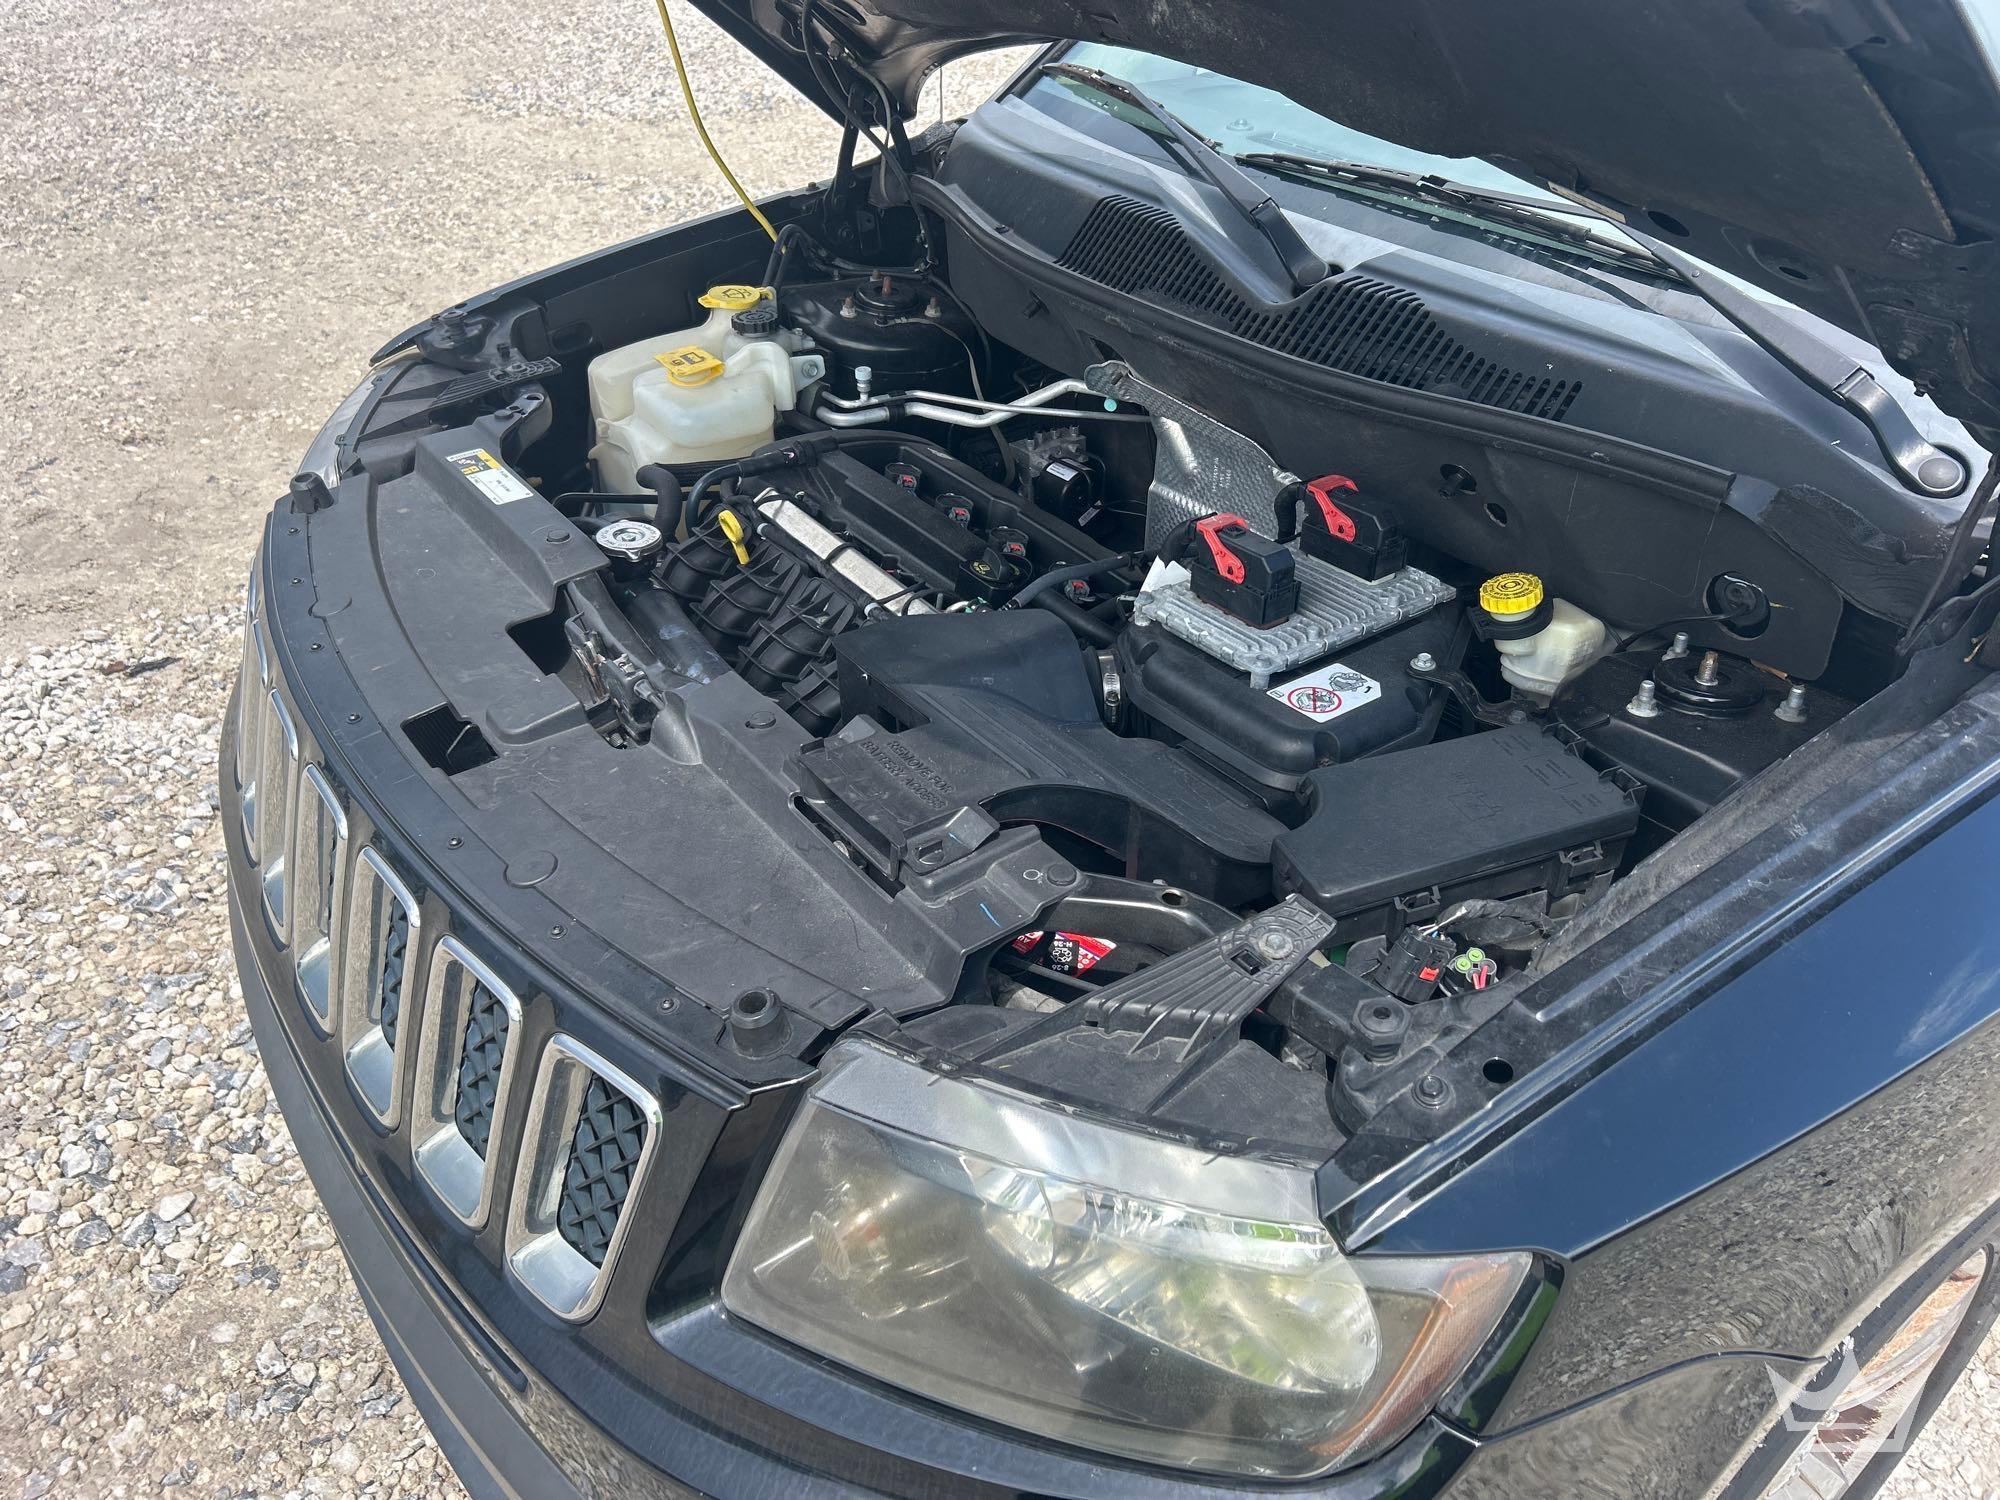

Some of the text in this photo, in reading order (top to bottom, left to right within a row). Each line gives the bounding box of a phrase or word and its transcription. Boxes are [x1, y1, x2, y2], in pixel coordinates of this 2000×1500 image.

[860, 740, 949, 810] BATTERY ACCESS
[886, 741, 956, 795] REMOVE FOR
